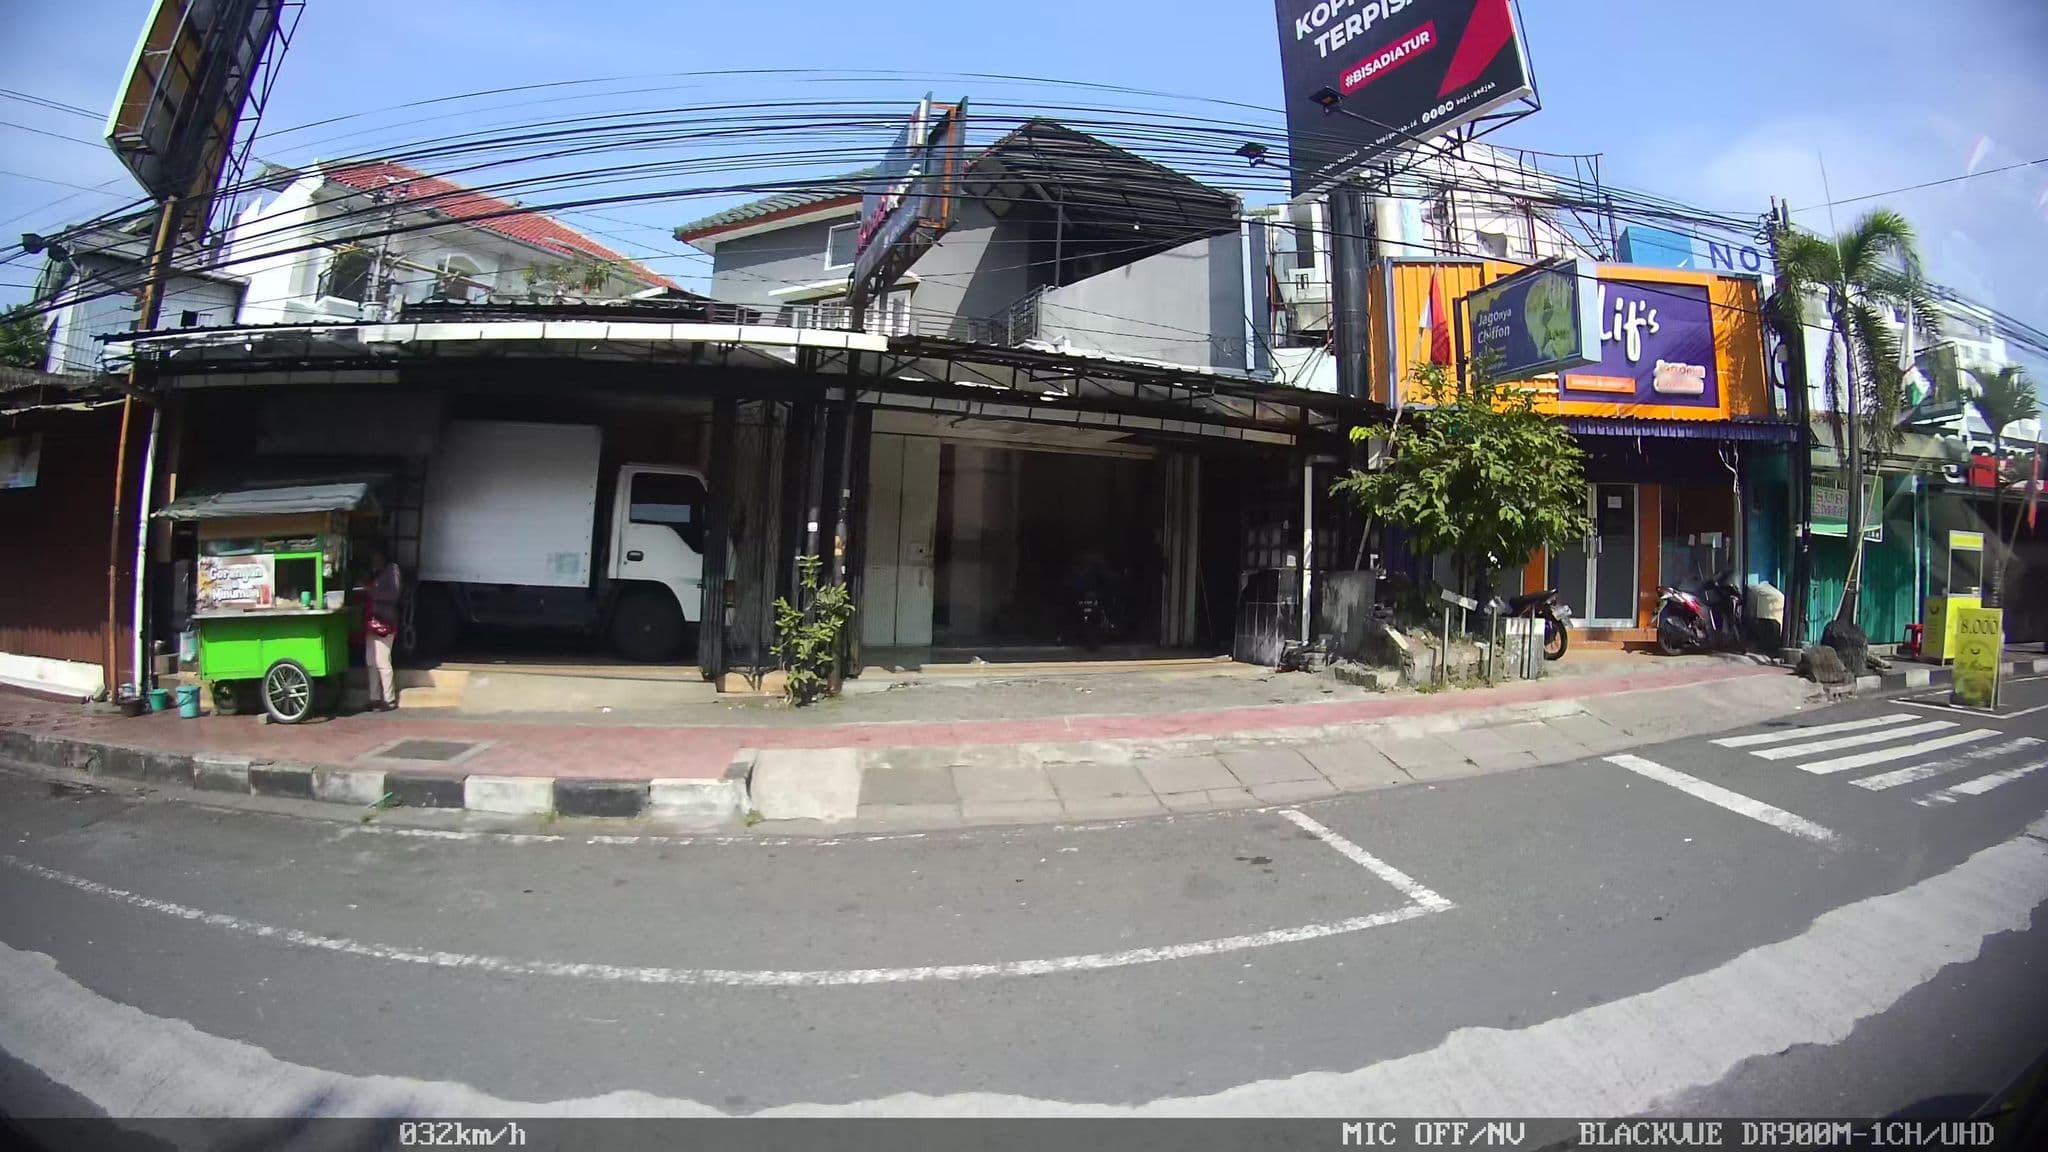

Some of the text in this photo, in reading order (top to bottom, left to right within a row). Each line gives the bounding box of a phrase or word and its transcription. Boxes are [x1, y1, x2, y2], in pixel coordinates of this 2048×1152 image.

[1344, 31, 1430, 88] #BISADIATUR
[1478, 308, 1512, 327] Jagonya
[1477, 325, 1510, 344] Chiffon
